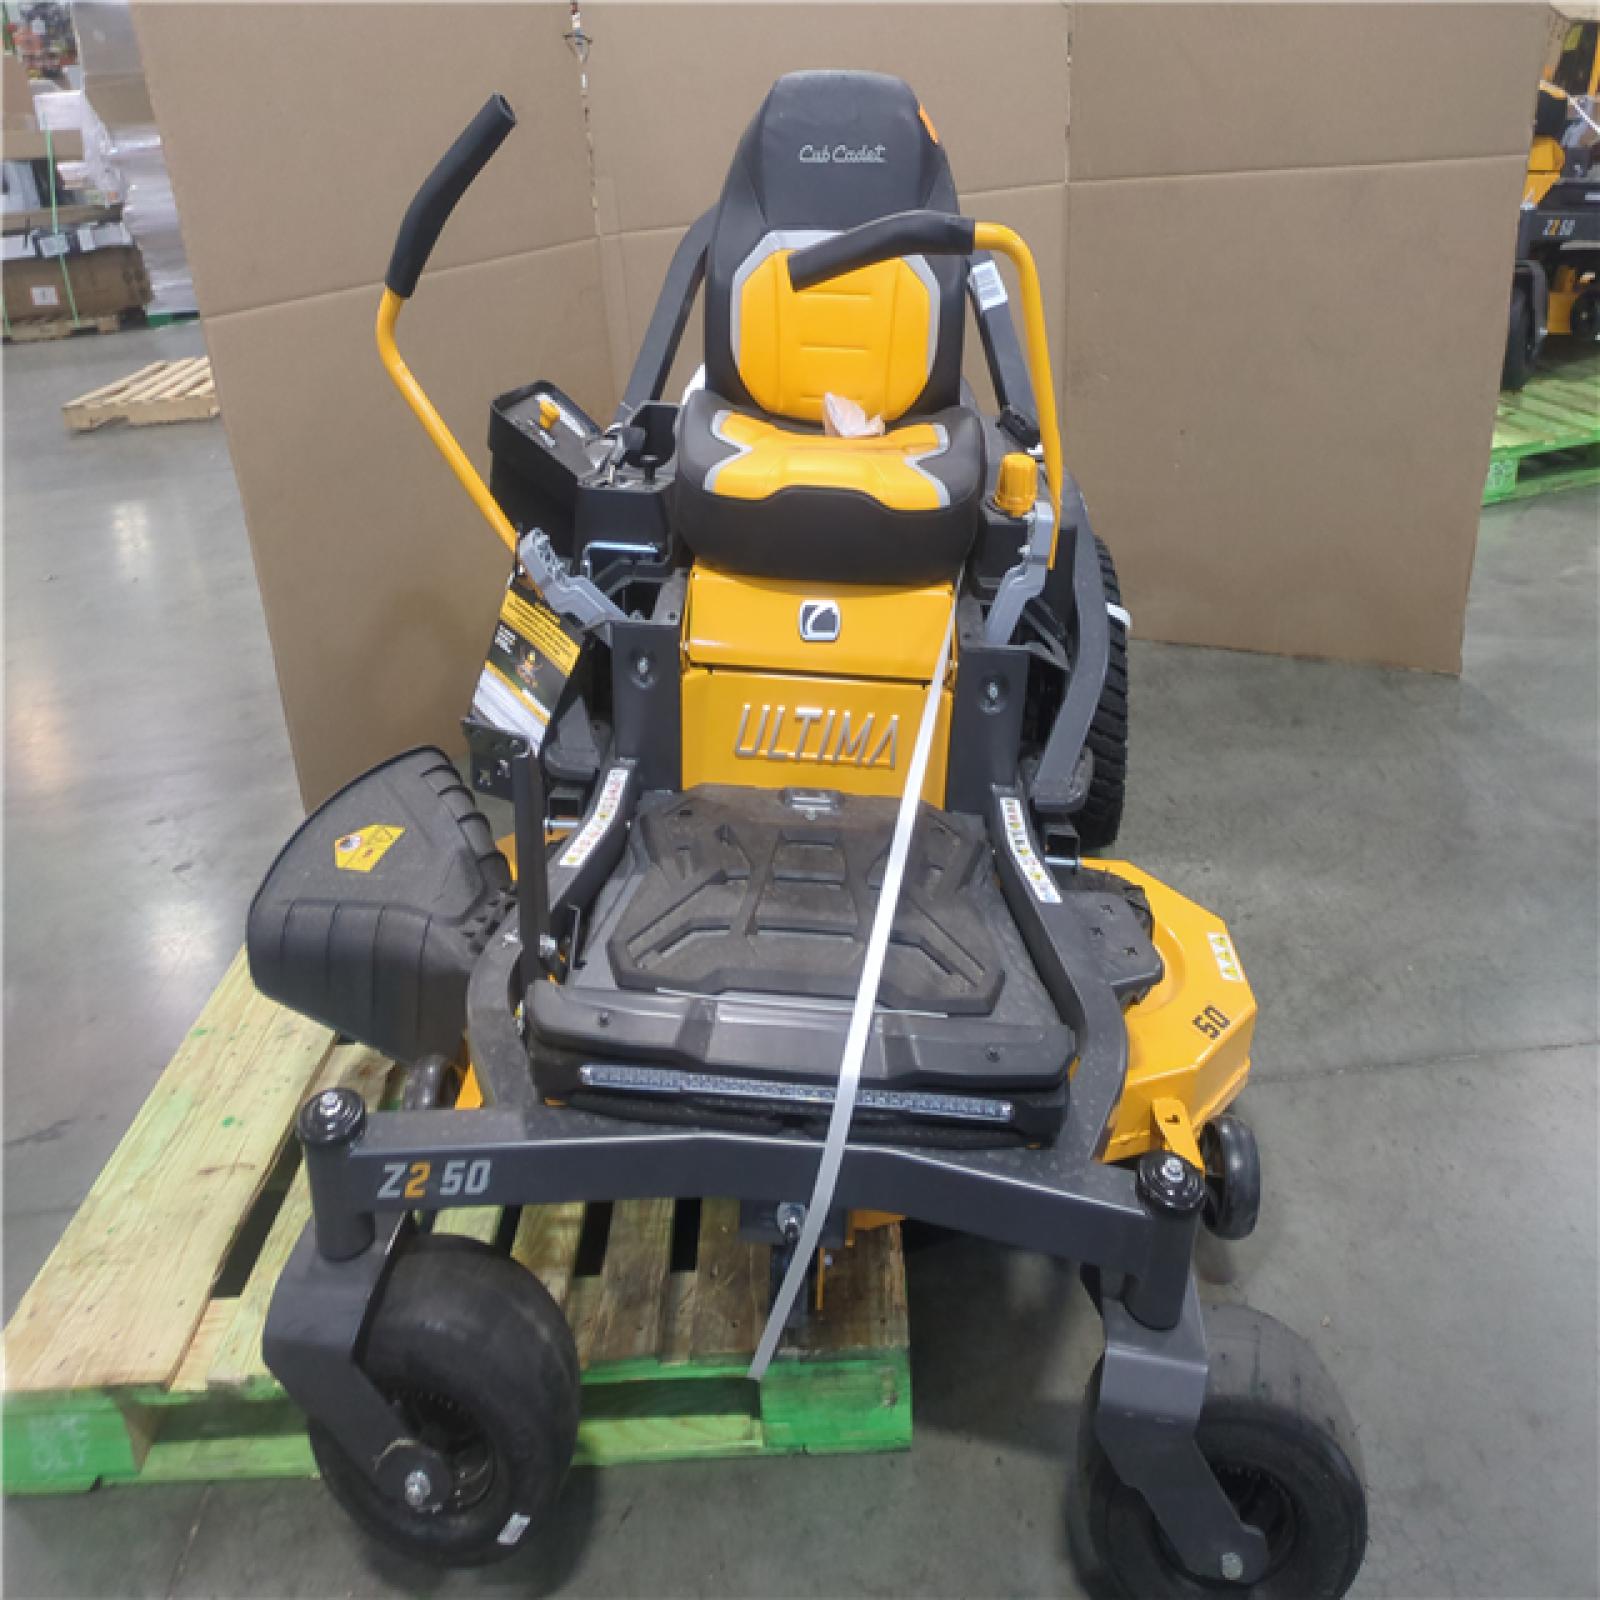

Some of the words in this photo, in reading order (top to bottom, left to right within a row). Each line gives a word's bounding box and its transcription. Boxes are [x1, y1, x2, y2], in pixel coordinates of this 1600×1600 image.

[799, 144, 831, 163] Cub
[832, 144, 887, 163] Cadet
[734, 703, 900, 769] ULTIMA
[1192, 1004, 1231, 1040] 50
[377, 1160, 432, 1199] Z2
[439, 1159, 492, 1196] 50
